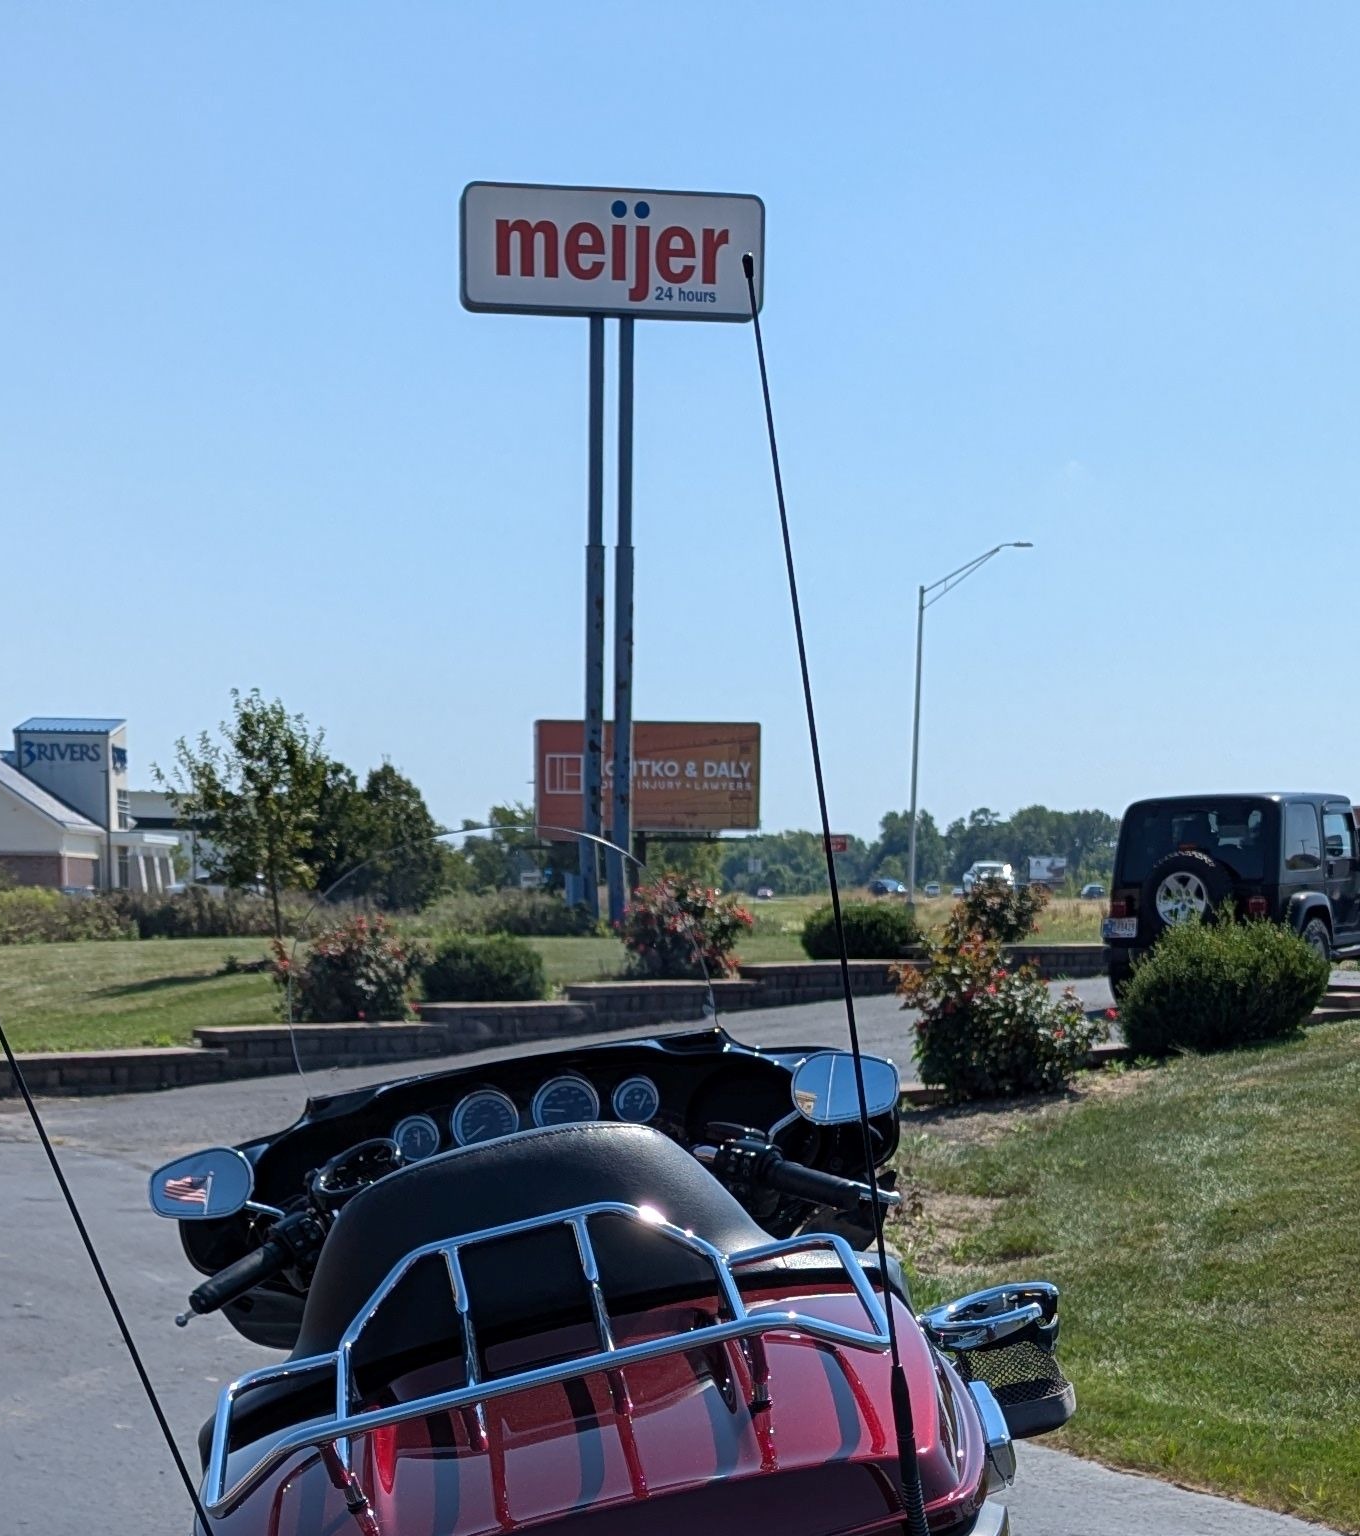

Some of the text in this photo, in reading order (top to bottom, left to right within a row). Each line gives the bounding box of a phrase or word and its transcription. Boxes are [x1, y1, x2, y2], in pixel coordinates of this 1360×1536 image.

[496, 200, 729, 302] meijer
[655, 287, 717, 303] 24 hours
[684, 761, 697, 778] &
[703, 761, 751, 778] DALY
[636, 780, 752, 791] INJURY LAWYERS
